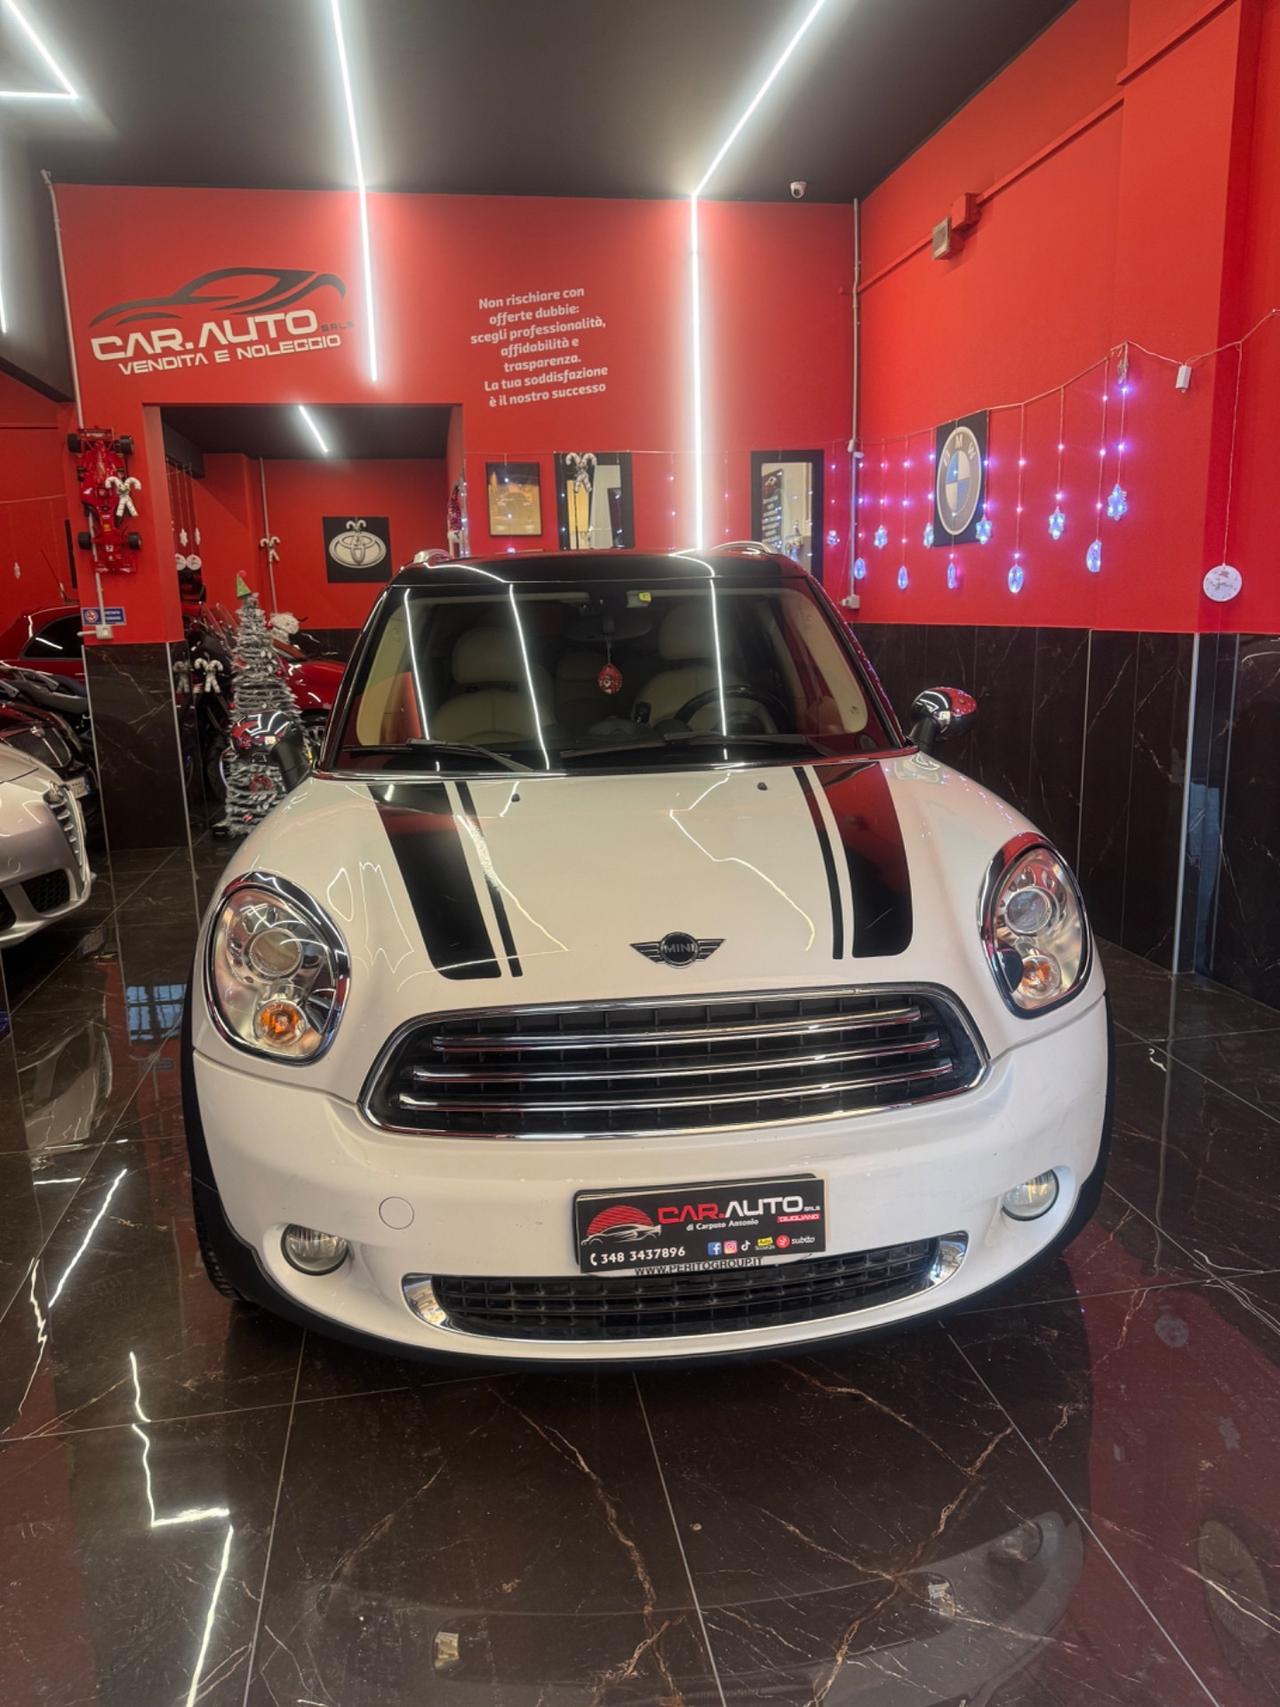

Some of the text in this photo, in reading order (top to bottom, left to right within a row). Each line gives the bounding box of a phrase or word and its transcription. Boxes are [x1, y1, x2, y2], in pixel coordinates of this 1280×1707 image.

[479, 288, 585, 309] Non rischiare con
[489, 304, 580, 327] offerte dubbie:
[470, 316, 607, 345] scegli professionalità,
[118, 334, 342, 376] VENDITA E NOLEGGIO
[501, 338, 580, 358] affidabilità e
[504, 354, 581, 373] trasparenza.
[484, 366, 608, 391] La tua soddisfazione
[489, 383, 607, 408] è il nostro successo
[664, 943, 695, 954] MINI
[686, 1223, 694, 1231] di
[728, 1218, 759, 1229] Antonio
[601, 1246, 686, 1265] 348 3437896
